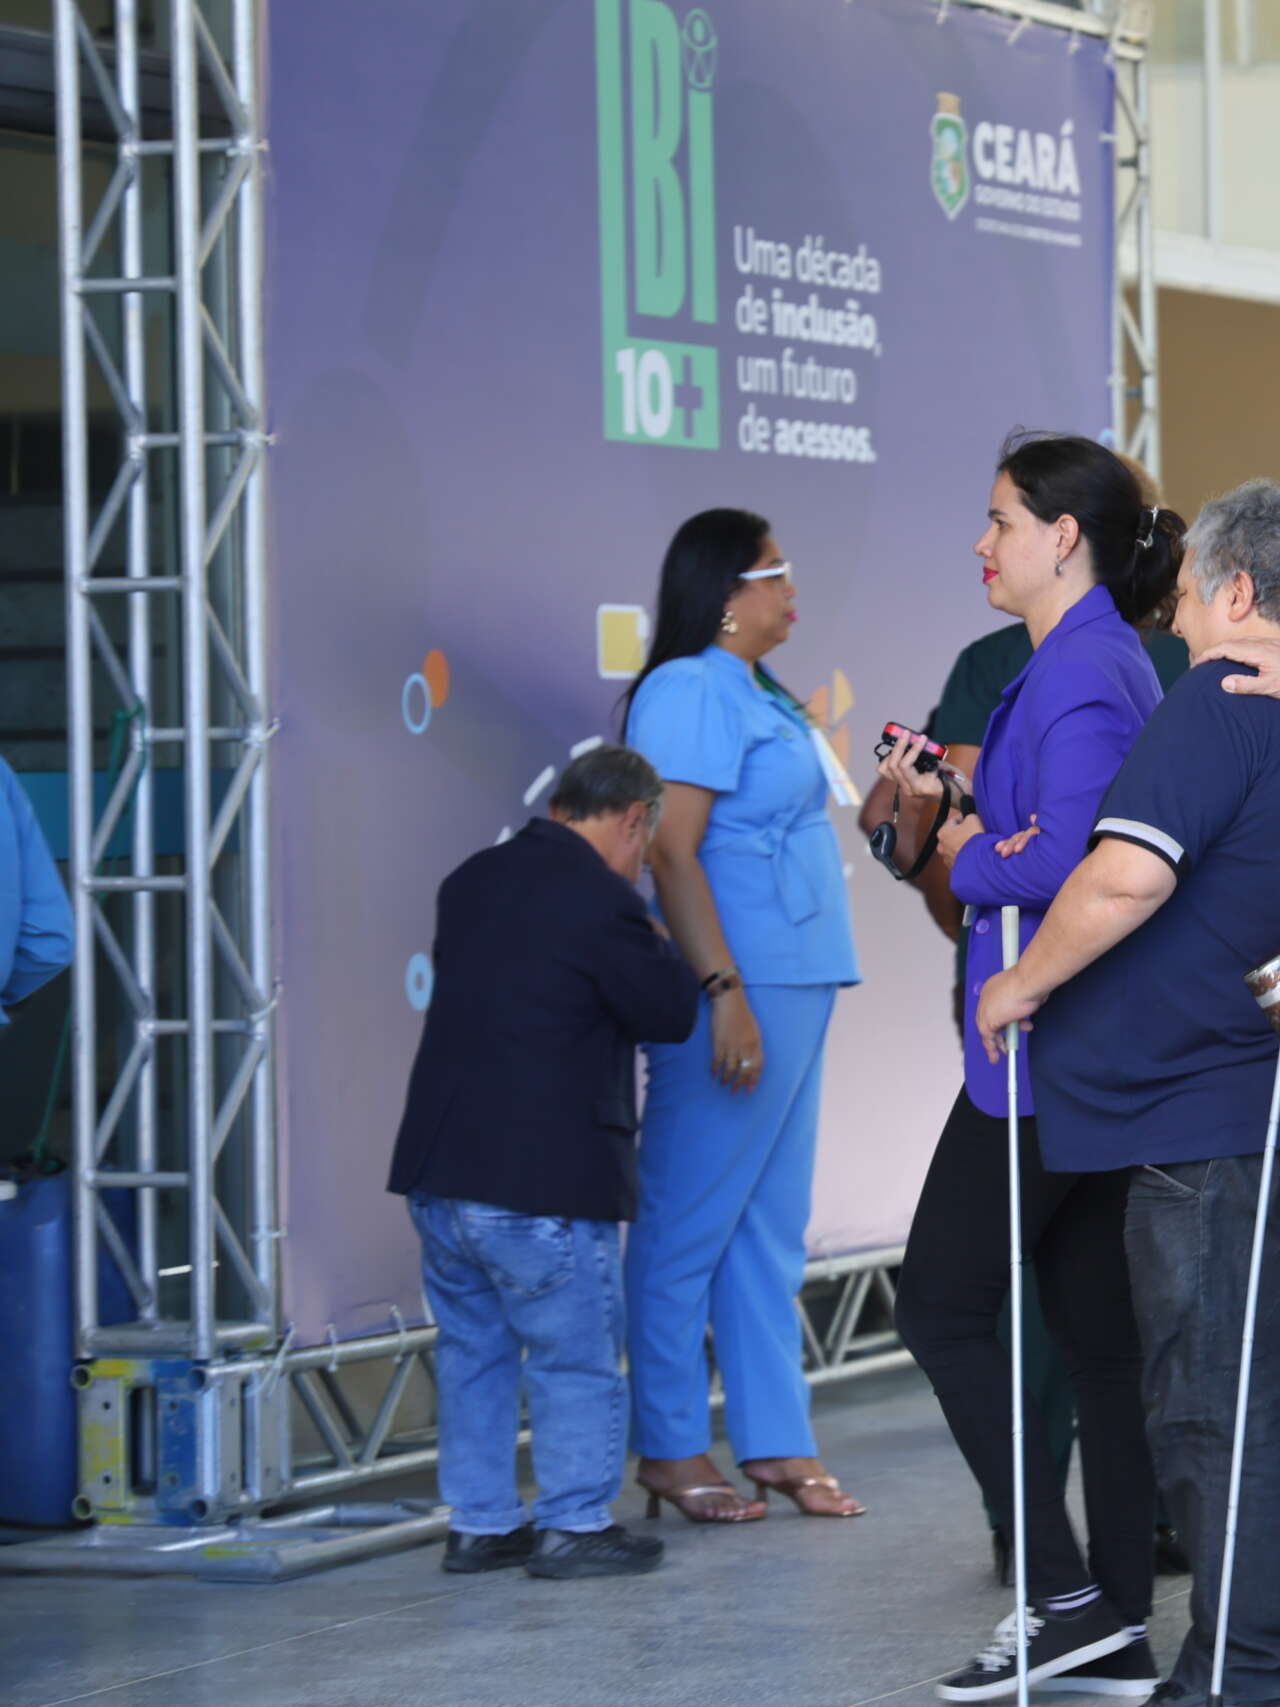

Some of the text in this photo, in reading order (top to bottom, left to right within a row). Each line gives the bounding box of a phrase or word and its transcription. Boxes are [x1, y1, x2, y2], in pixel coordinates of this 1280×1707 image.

[973, 118, 1081, 196] CEARÁ
[734, 225, 881, 294] Uma década
[735, 284, 882, 357] de inclusão,
[737, 347, 857, 404] um futuro
[738, 402, 877, 464] de acessos.
